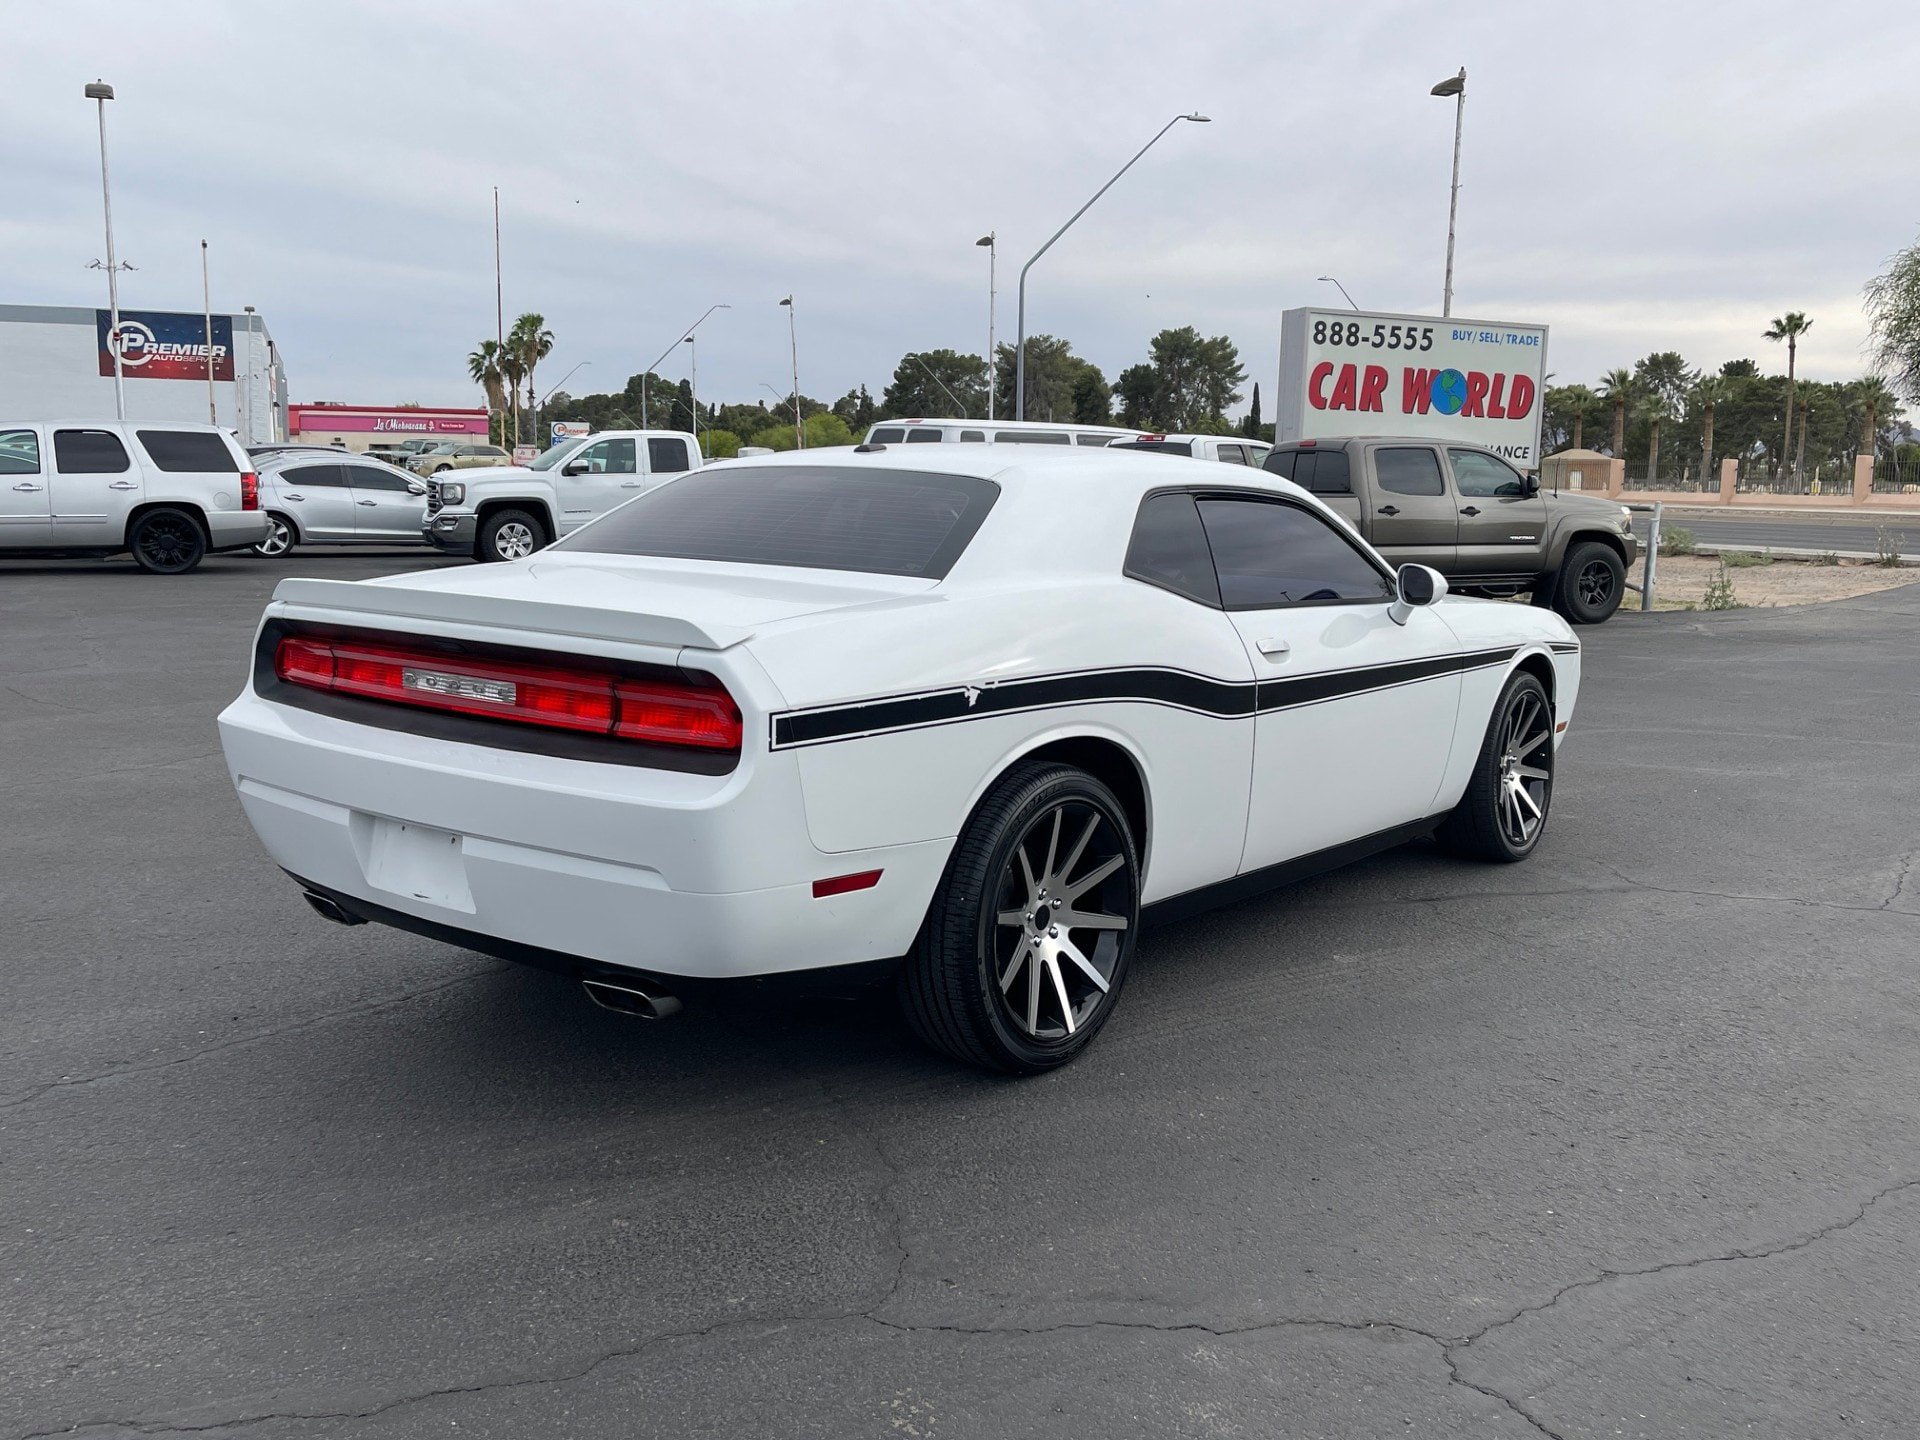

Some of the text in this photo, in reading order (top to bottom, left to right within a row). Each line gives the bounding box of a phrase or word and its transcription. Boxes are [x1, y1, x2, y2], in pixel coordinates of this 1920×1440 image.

[1313, 320, 1434, 352] 888-5555
[152, 353, 225, 364] AUTOSERVCE
[1308, 361, 1389, 413] CAR
